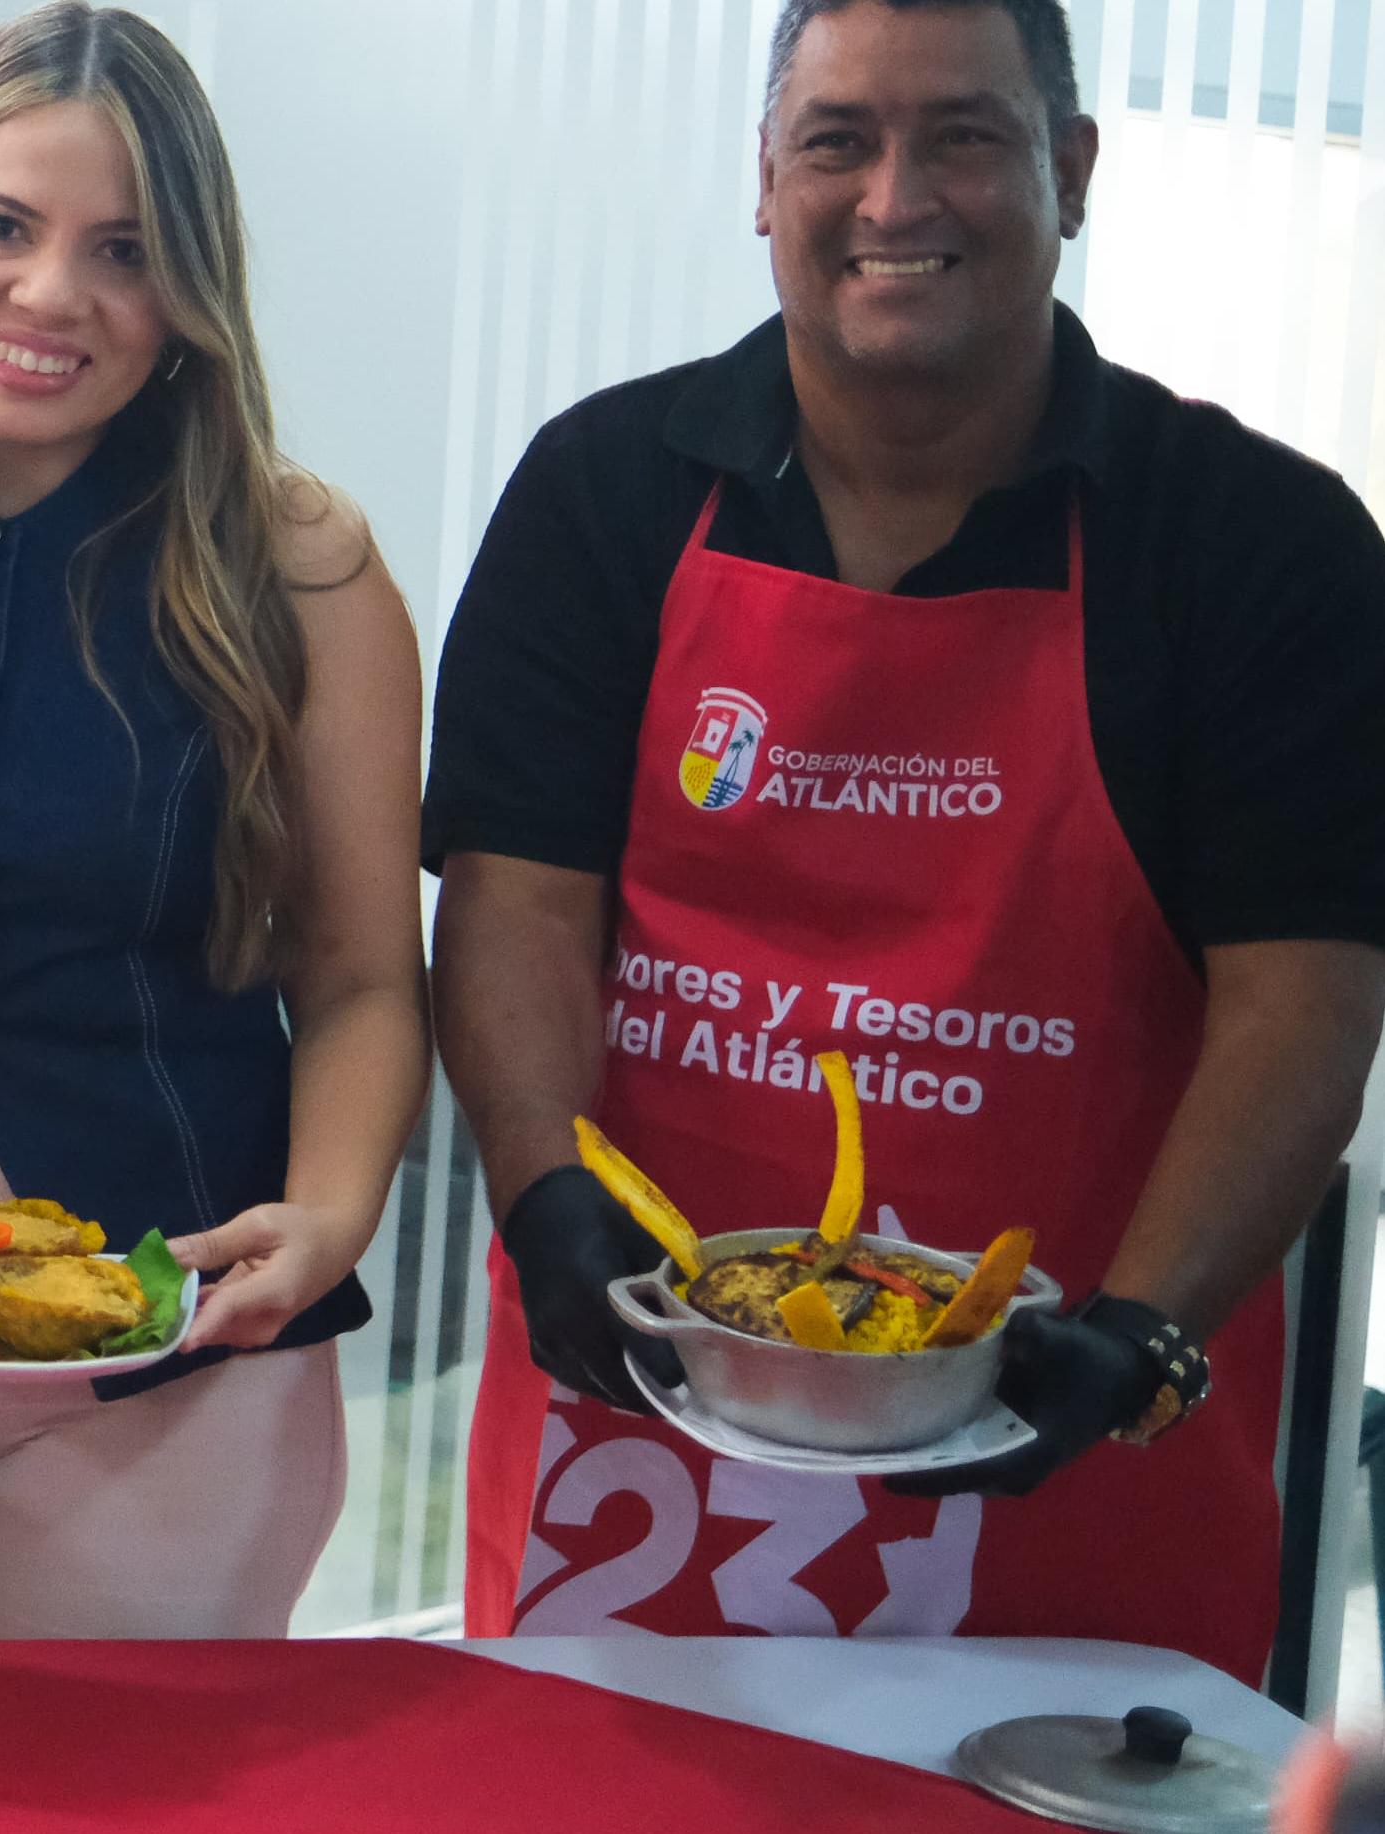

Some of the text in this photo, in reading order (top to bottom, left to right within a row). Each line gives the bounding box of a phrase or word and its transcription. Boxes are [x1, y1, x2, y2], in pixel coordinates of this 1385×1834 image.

[768, 745, 1000, 777] GOBERNACIÓN DEL
[756, 770, 1002, 817] ATLÁNTICO
[762, 980, 802, 1030] y
[827, 982, 1075, 1056] Tesoros
